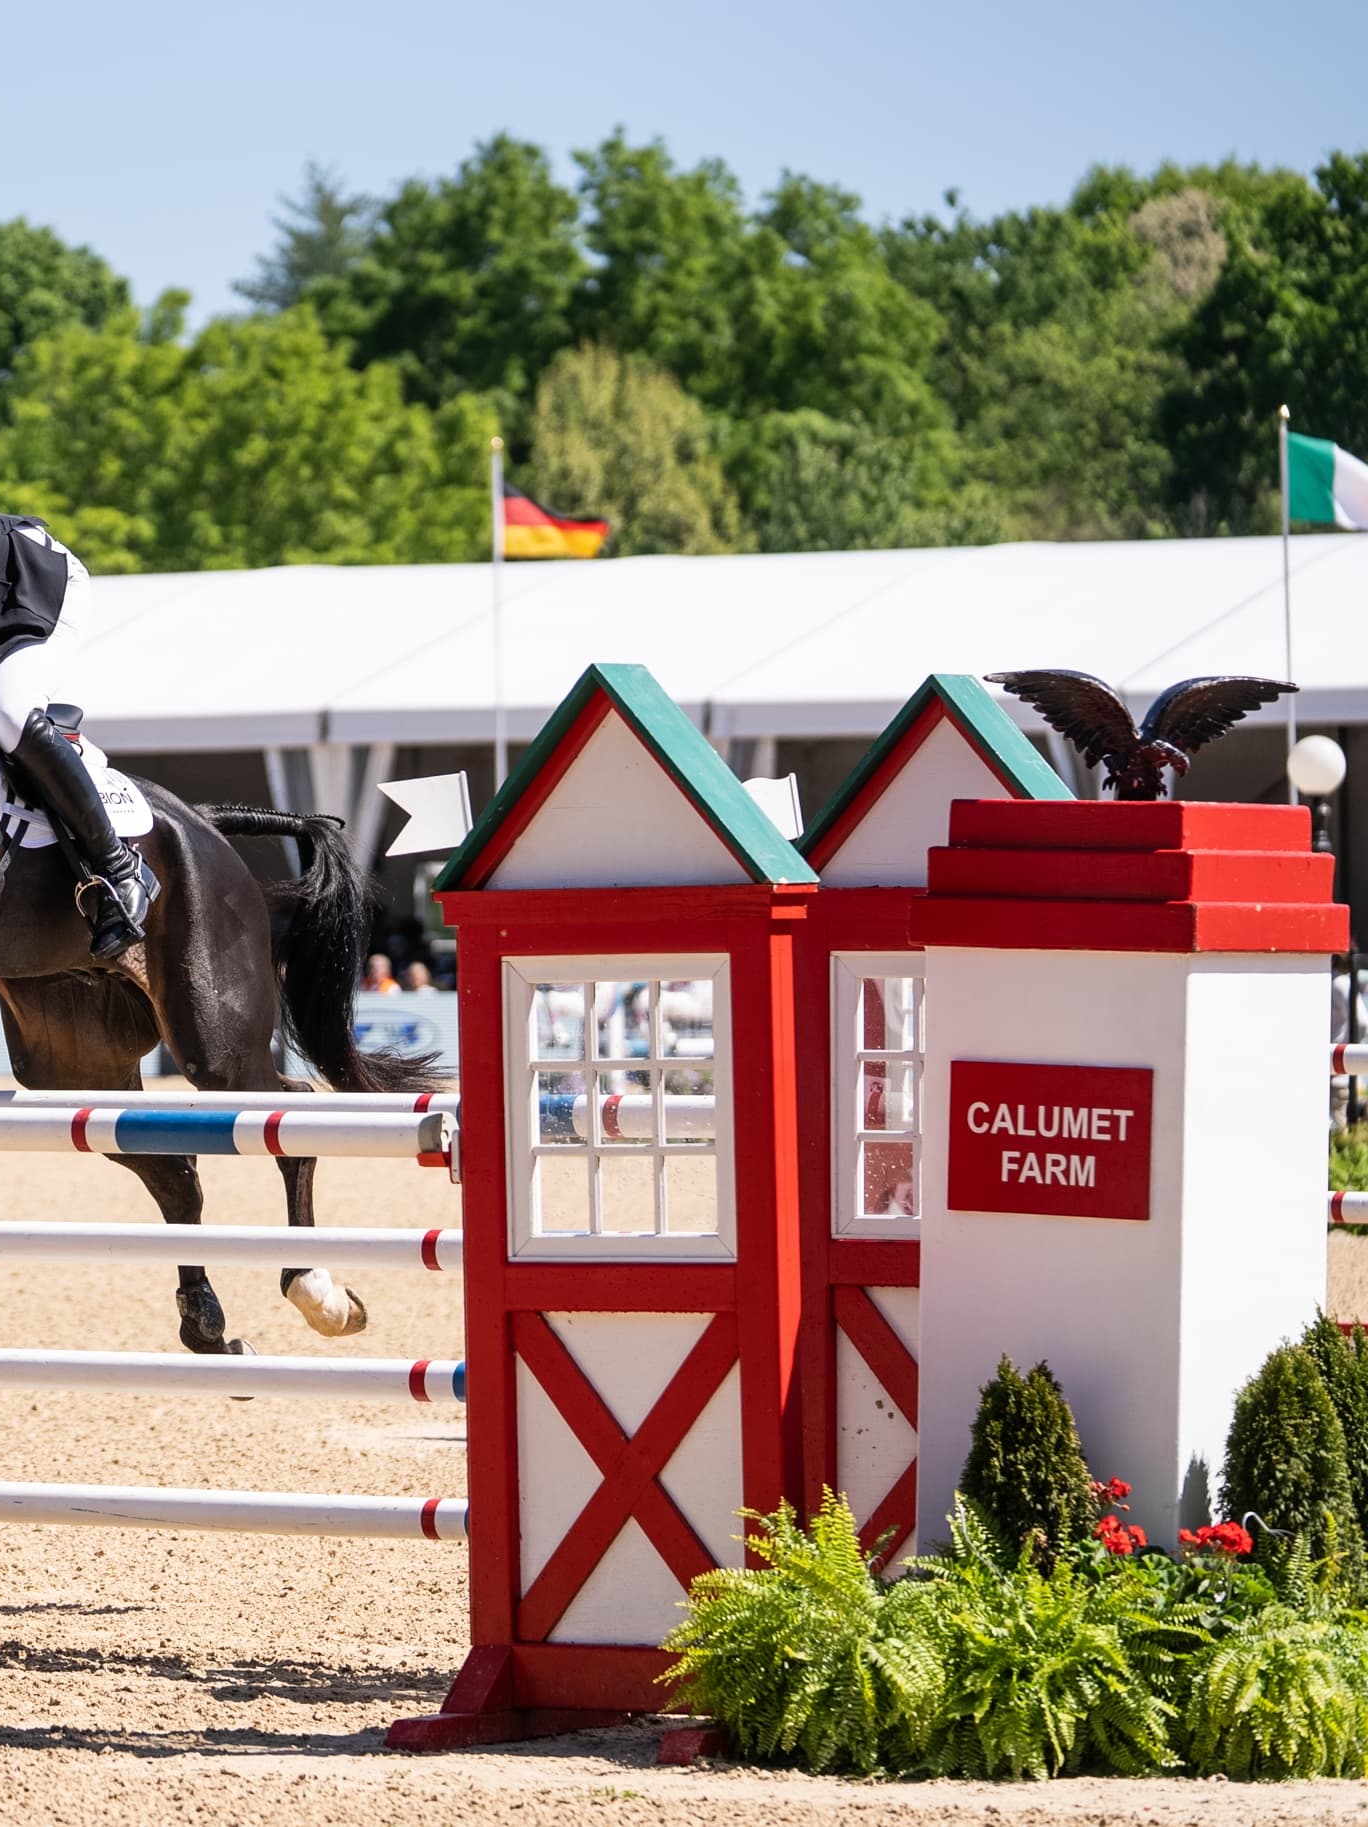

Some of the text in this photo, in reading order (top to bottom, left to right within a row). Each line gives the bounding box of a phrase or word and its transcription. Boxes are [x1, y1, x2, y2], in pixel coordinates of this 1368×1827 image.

[98, 792, 134, 805] BION
[967, 1101, 1134, 1142] CALUMET
[1001, 1150, 1096, 1188] FARM
